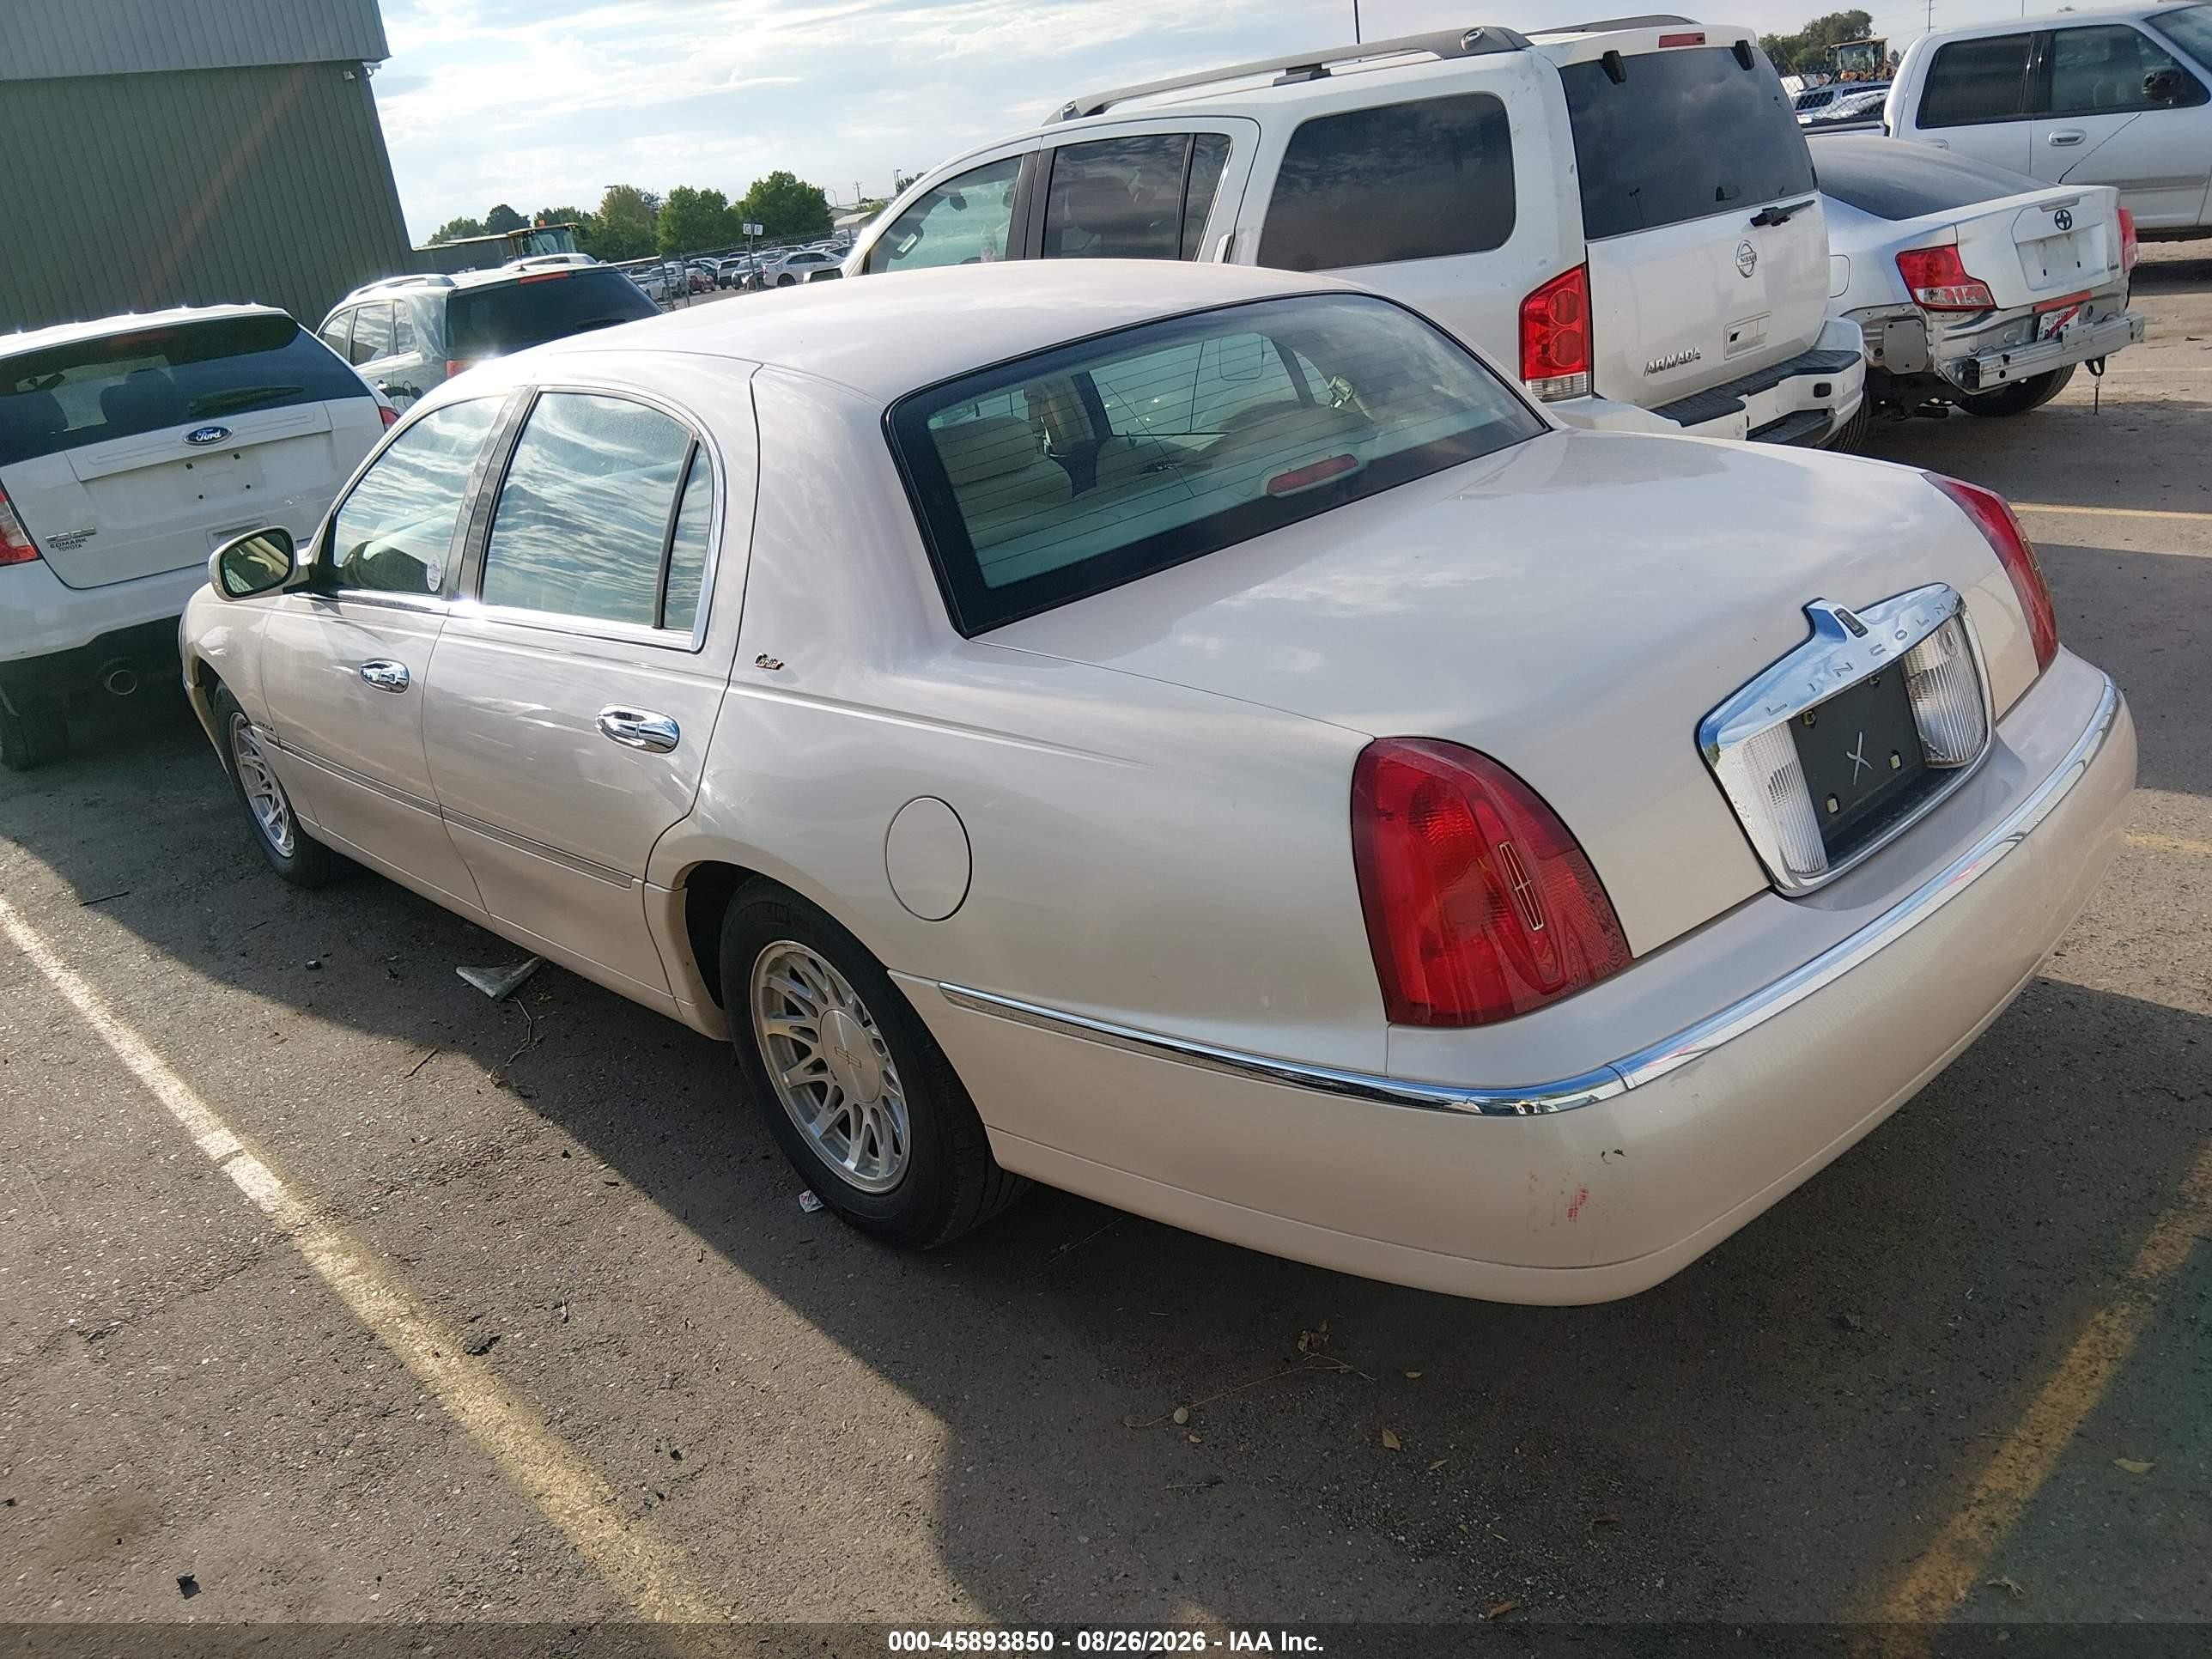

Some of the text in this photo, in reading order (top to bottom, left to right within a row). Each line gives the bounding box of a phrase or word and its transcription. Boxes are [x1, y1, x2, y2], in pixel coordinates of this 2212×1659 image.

[744, 225, 750, 234] G
[1643, 346, 1702, 376] ARMADA
[196, 428, 222, 442] Ford
[49, 537, 88, 550] EDMARK
[58, 543, 83, 552] TOYOTA
[1765, 602, 1948, 717] LINCOLN
